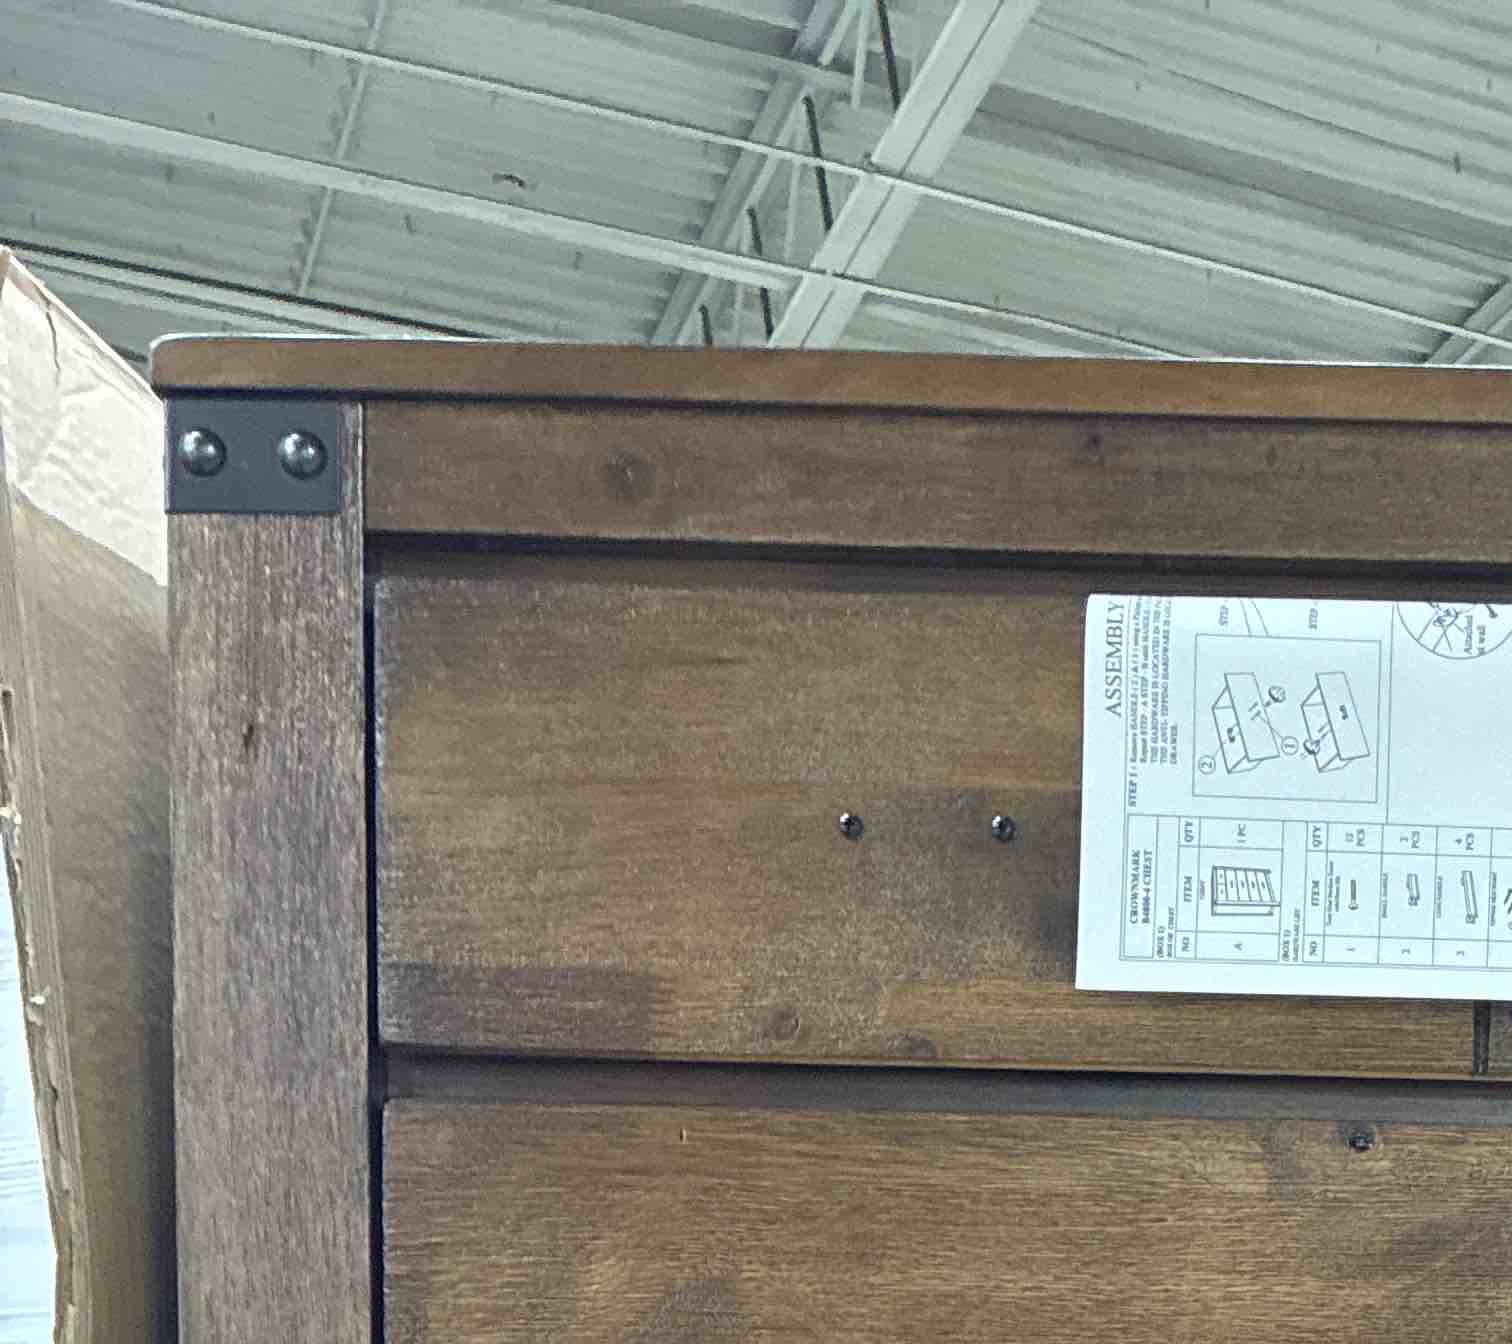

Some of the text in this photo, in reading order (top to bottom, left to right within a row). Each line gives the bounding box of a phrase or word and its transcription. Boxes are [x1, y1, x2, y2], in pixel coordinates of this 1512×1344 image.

[1464, 615, 1473, 655] Attached
[1476, 625, 1486, 644] wall
[1105, 601, 1124, 719] ASSEMBLY
[1128, 780, 1136, 808] STEP
[1238, 824, 1246, 837] PC
[1356, 828, 1366, 847] PCS
[1411, 830, 1420, 848] PCS
[1465, 832, 1474, 850] PCS
[1143, 849, 1152, 885] CHEST
[1130, 849, 1140, 924] CROWNMARK
[1182, 820, 1194, 952] NO ITEM QTY
[1310, 825, 1322, 956] NO ITEM QTY
[1156, 936, 1164, 958] (BOX
[1282, 940, 1290, 962] (BOX
